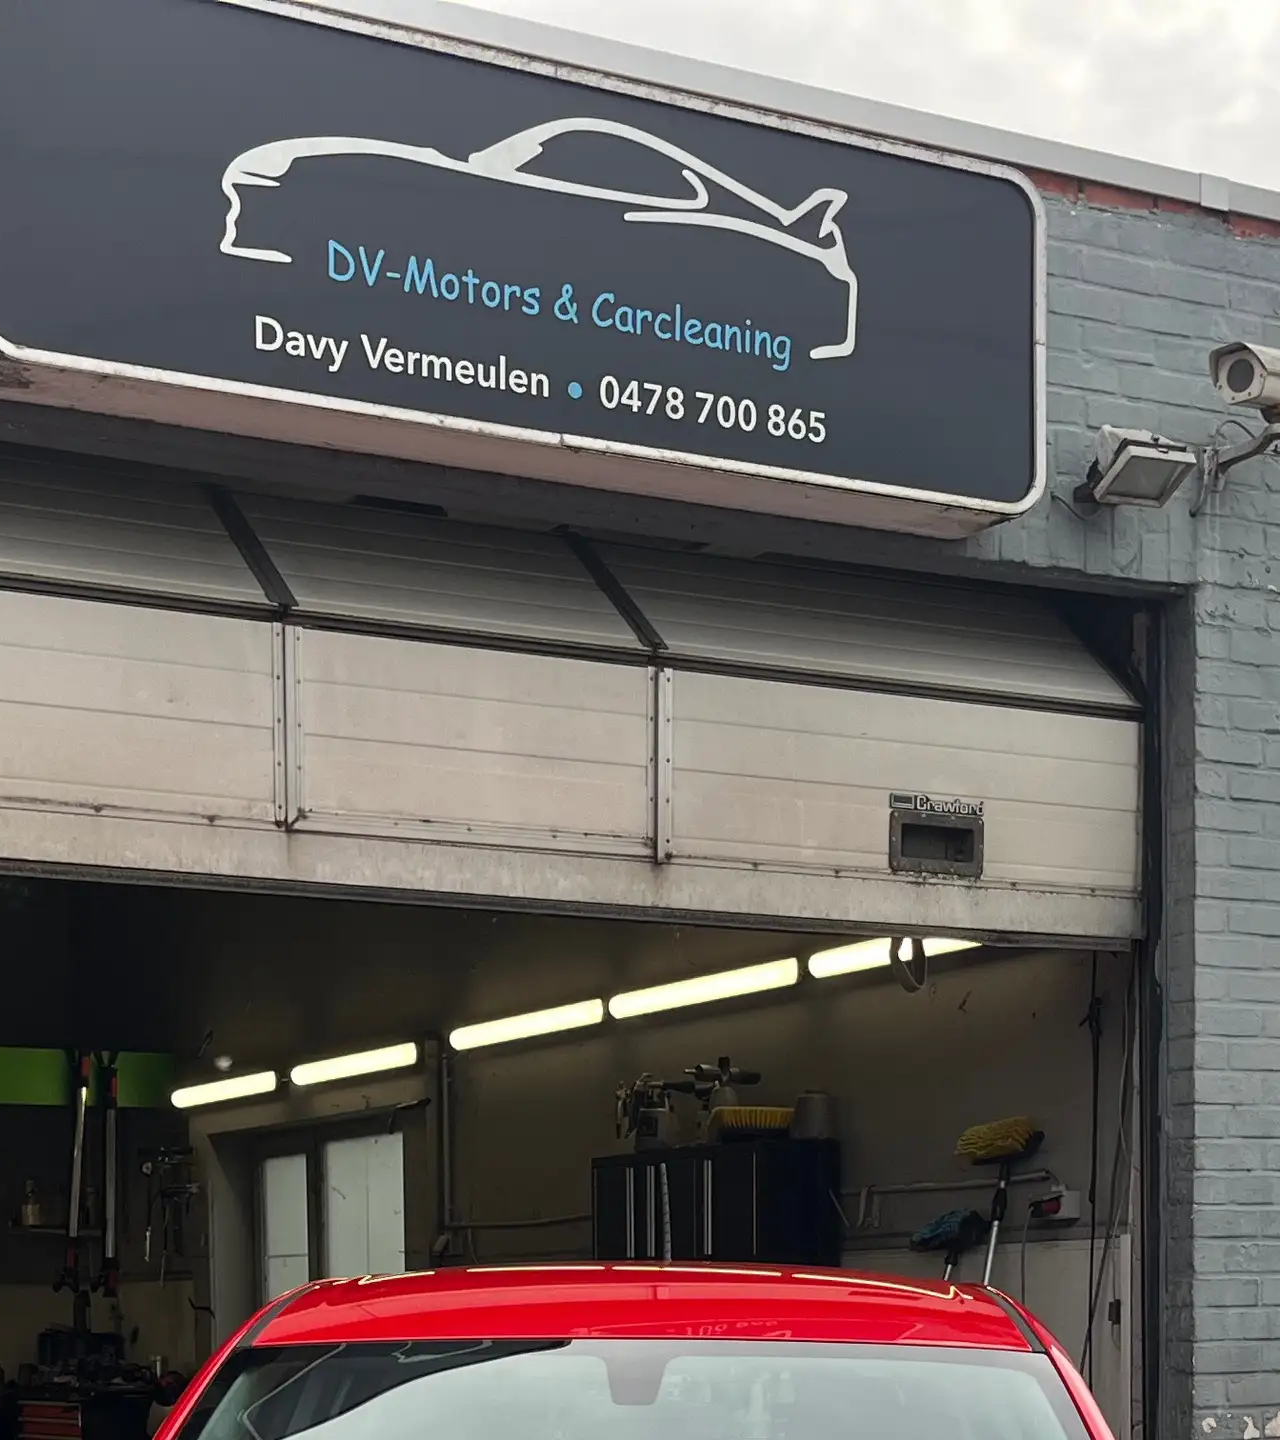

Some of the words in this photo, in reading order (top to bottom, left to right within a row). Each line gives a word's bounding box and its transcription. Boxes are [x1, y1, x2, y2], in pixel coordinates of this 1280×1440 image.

[327, 239, 540, 316] DV-Motors
[553, 283, 579, 324] &
[591, 291, 792, 372] Carcleaning
[254, 314, 349, 373] Davy
[360, 333, 550, 398] Vermeulen
[599, 374, 685, 420] 0478
[695, 390, 757, 432] 700
[767, 403, 827, 443] 865
[916, 795, 985, 816] Crawford
